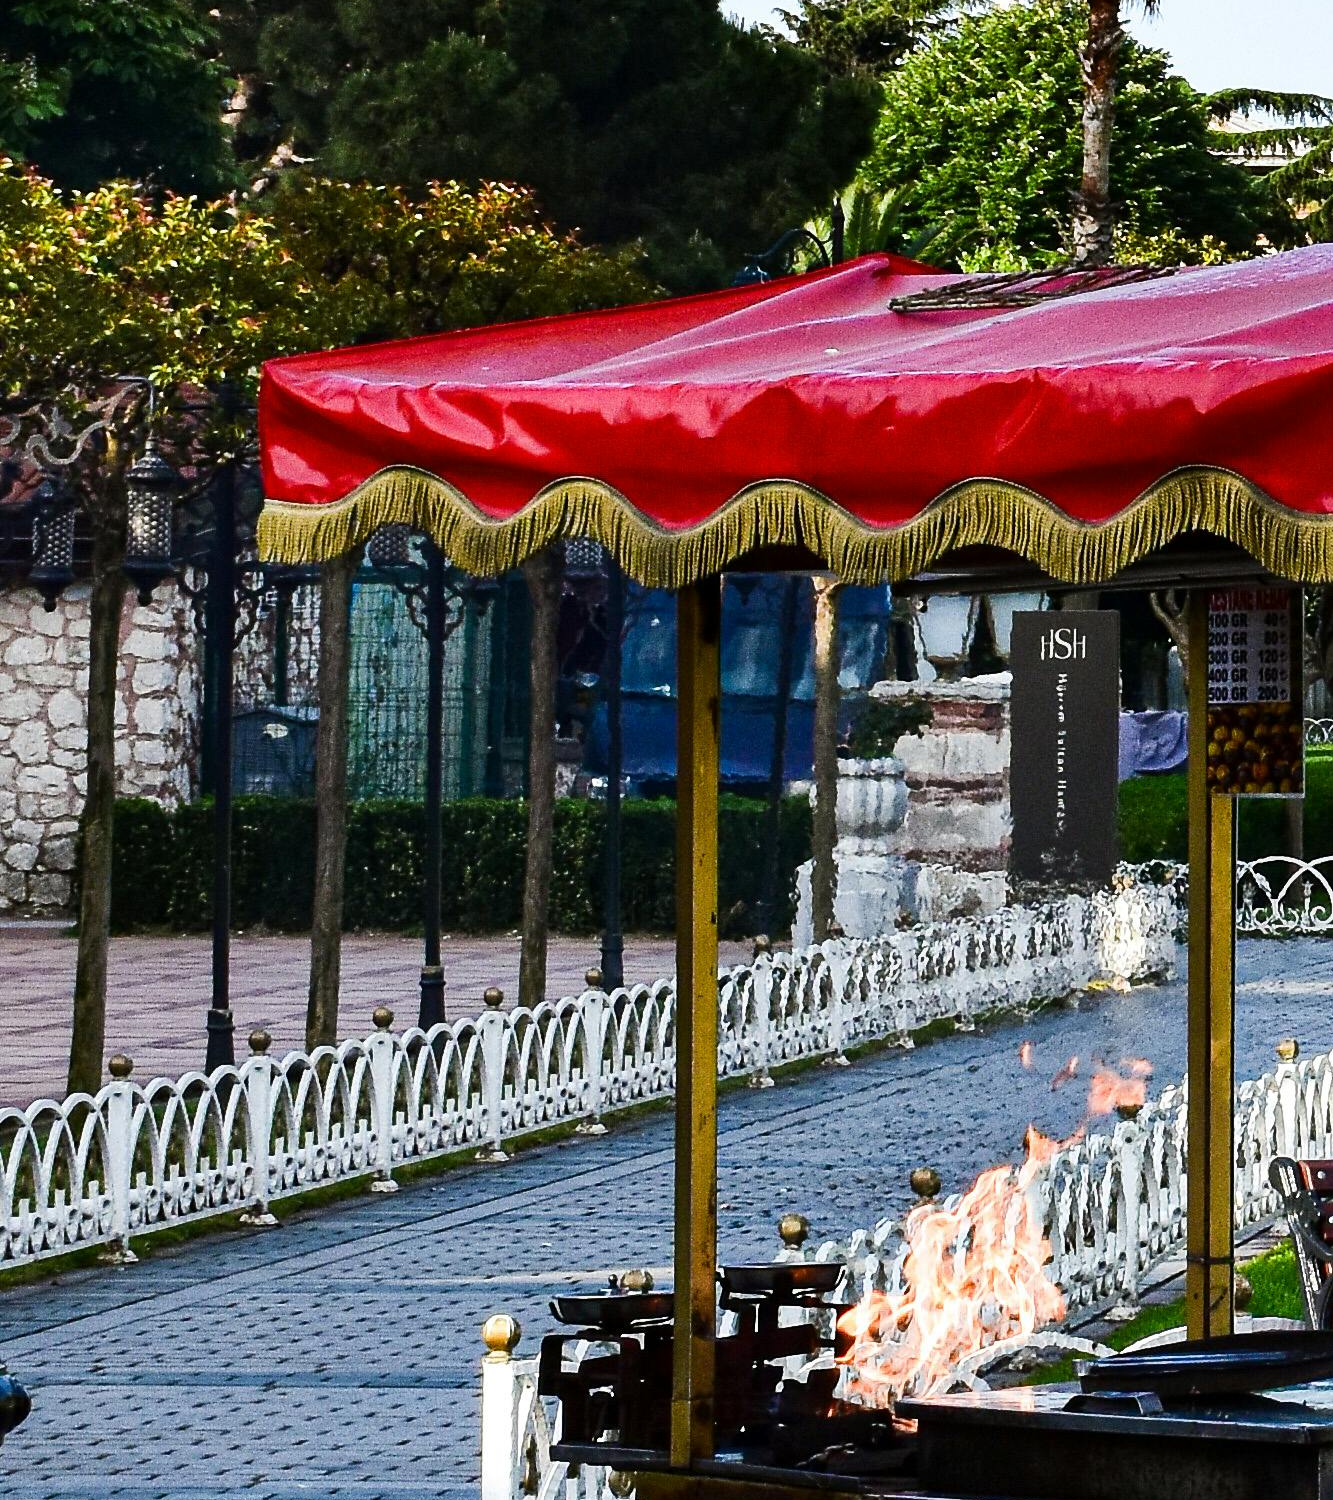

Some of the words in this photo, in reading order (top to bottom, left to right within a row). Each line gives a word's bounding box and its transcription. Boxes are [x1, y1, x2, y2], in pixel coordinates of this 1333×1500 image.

[1209, 613, 1228, 627] 100
[1231, 613, 1247, 627] GR
[1041, 628, 1086, 660] HSH
[1209, 631, 1228, 645] 200
[1231, 631, 1247, 645] GR
[1209, 650, 1228, 664] 300
[1231, 650, 1247, 664] GR
[1209, 668, 1228, 682] 400
[1231, 668, 1247, 682] GR
[1209, 686, 1228, 700] 500
[1231, 686, 1247, 700] GR
